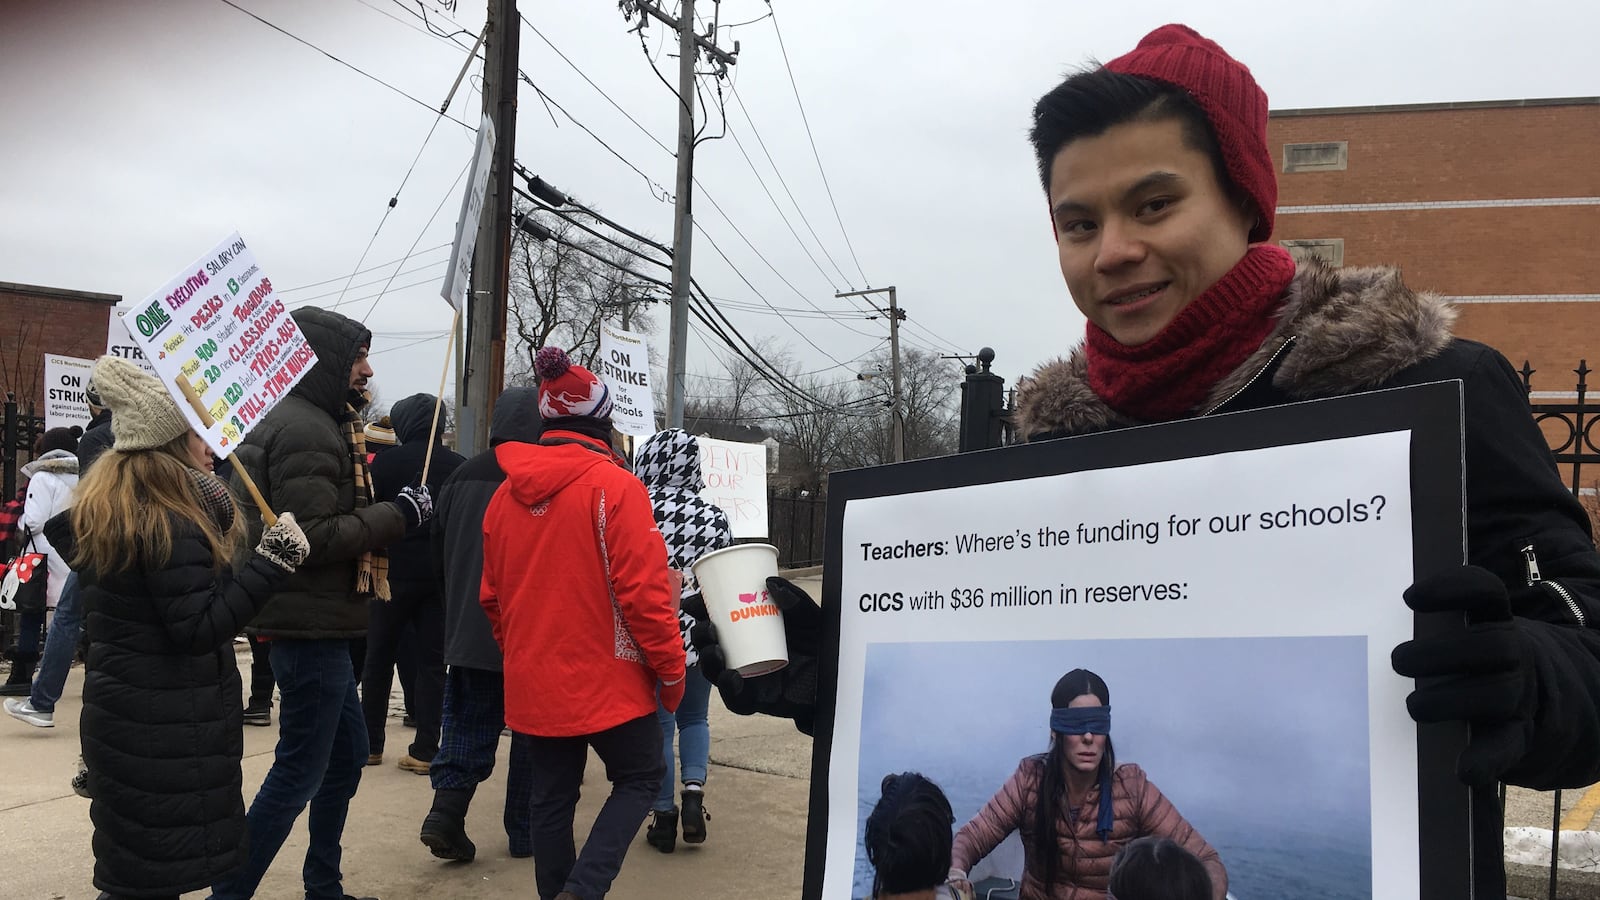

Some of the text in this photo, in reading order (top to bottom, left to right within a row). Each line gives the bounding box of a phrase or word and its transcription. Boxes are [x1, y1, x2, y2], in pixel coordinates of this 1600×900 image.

[136, 299, 171, 337] ONE
[165, 268, 210, 311] EXECUTIVE
[206, 247, 235, 276] SALARY
[231, 236, 247, 256] CAN
[226, 277, 240, 296] 13
[223, 292, 232, 303] in
[190, 294, 224, 329] DESKS
[181, 324, 195, 337] the
[163, 334, 185, 353] Replace
[181, 358, 201, 377] Provide
[194, 338, 218, 362] 400
[216, 317, 238, 343] student
[203, 364, 222, 384] 20
[220, 357, 234, 373] new
[228, 299, 285, 362] CLASSROOMS
[611, 349, 631, 368] ON
[61, 374, 81, 388] ON
[604, 360, 648, 387] STRIKE
[49, 388, 88, 403] STRIK
[209, 398, 229, 420] Fund
[224, 382, 244, 406] 120
[239, 370, 257, 391] field
[618, 385, 627, 393] for
[615, 393, 633, 405] safe
[613, 402, 643, 418] chools
[222, 425, 240, 441] Pay
[230, 415, 245, 434] 2
[698, 445, 765, 477] DENTS
[860, 495, 1387, 561] Teachers: Where's the funding for our schools?
[859, 581, 1189, 613] CICS with $36 million in reserves:
